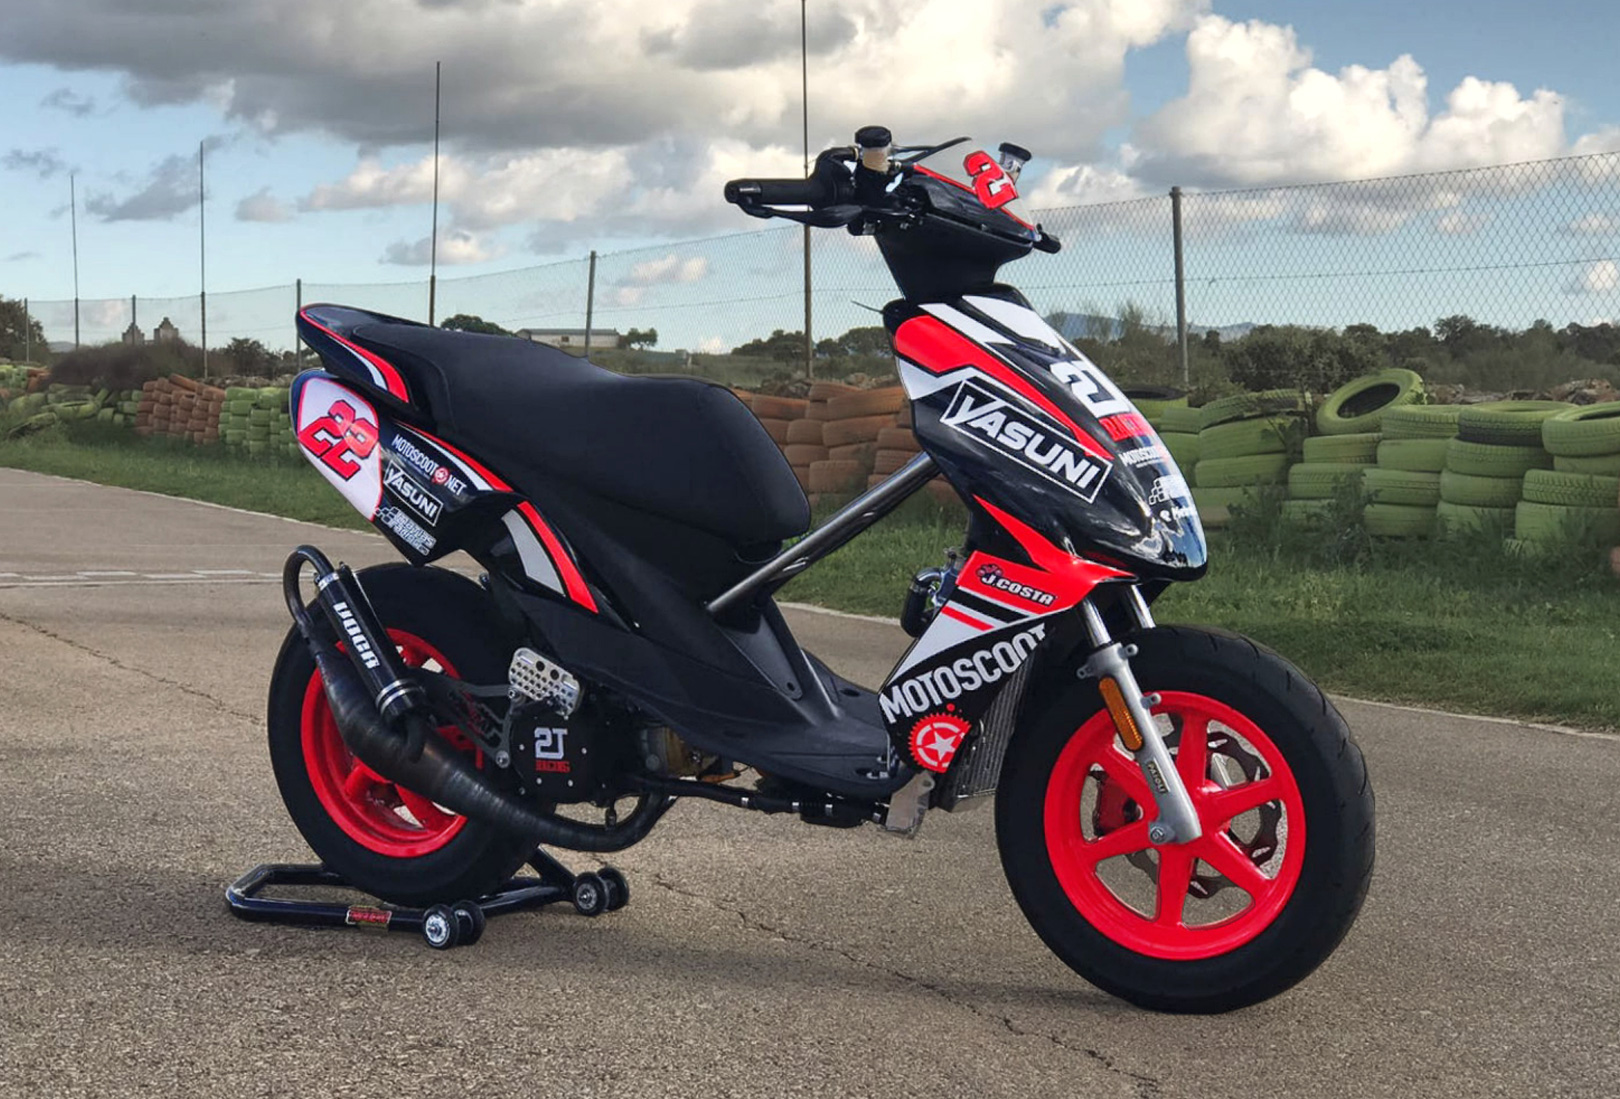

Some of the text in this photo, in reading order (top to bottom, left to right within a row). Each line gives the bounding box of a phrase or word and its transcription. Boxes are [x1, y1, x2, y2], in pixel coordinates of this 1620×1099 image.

[298, 399, 379, 481] 22
[391, 433, 440, 476] MOTOSCOOT
[444, 474, 467, 496] NET
[948, 393, 1101, 490] YASUNI
[384, 467, 438, 518] YASUNI
[981, 573, 1054, 606] J.COSTA
[879, 622, 1046, 724] MOTOSCOOT
